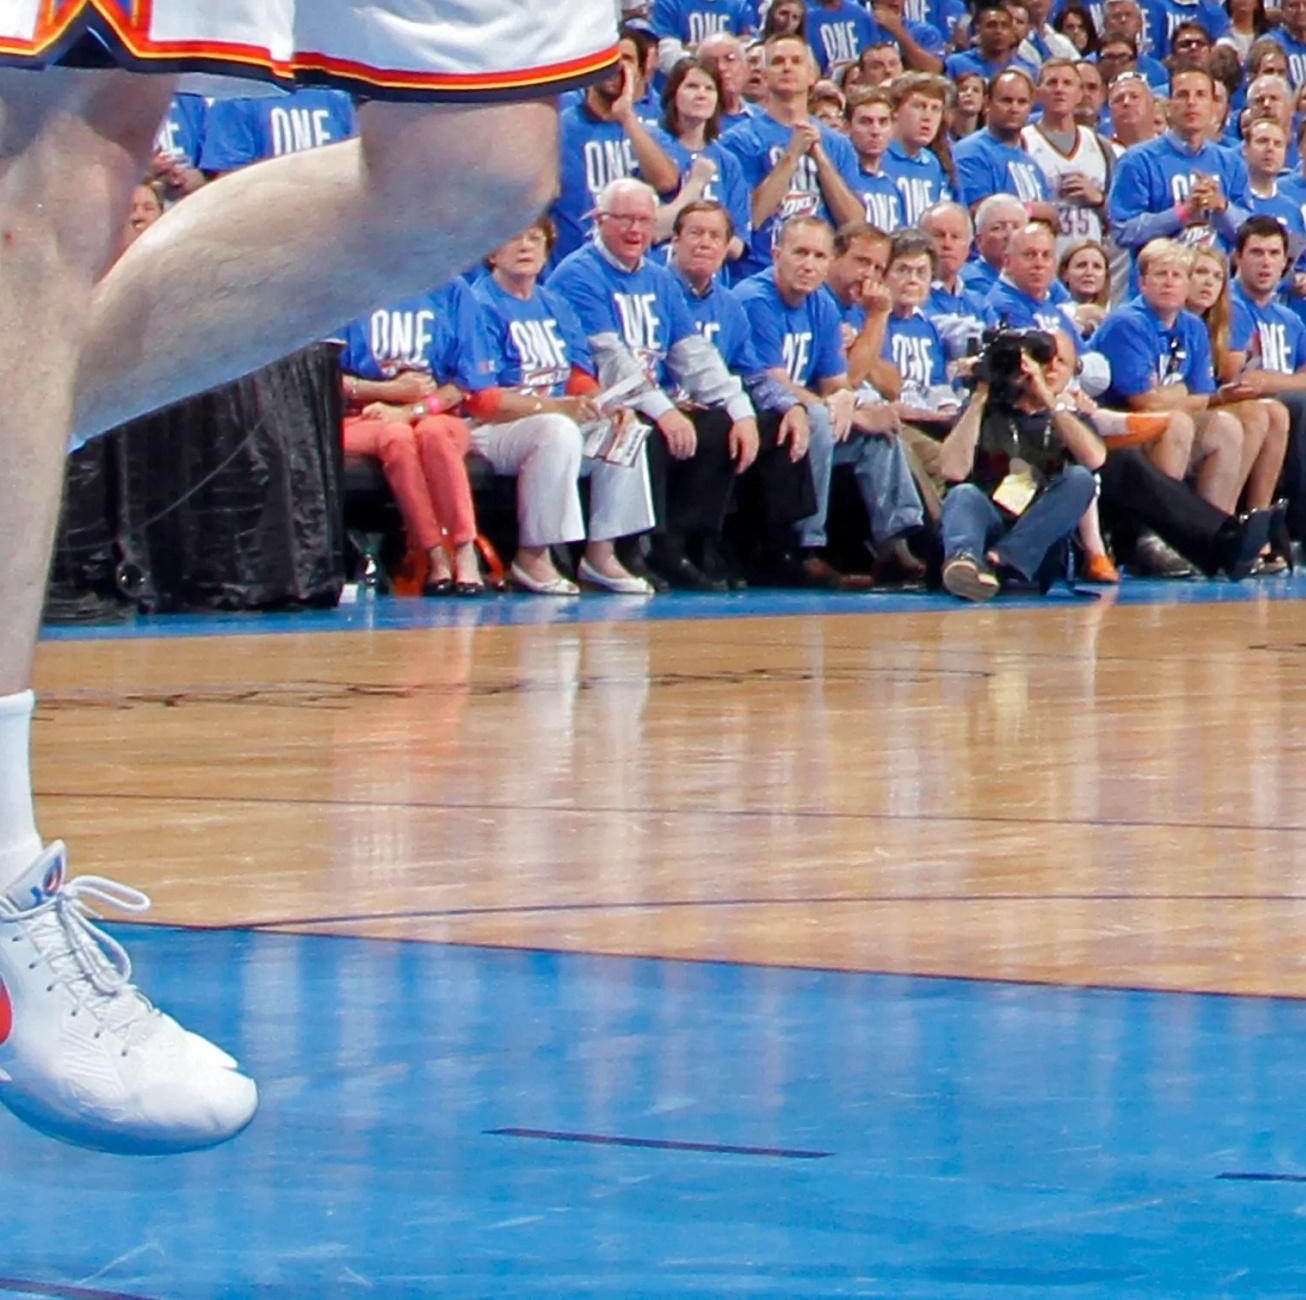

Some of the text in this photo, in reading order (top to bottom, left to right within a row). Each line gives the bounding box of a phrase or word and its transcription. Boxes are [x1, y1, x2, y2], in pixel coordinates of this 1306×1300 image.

[689, 11, 730, 42] ONE
[819, 21, 859, 62] ONE
[272, 107, 332, 156] ONE
[864, 193, 899, 233] ONE
[371, 309, 434, 367] ONE
[510, 319, 567, 370] ONE
[783, 332, 813, 387] NE
[892, 335, 932, 385] ONE
[1258, 323, 1293, 373] NE
